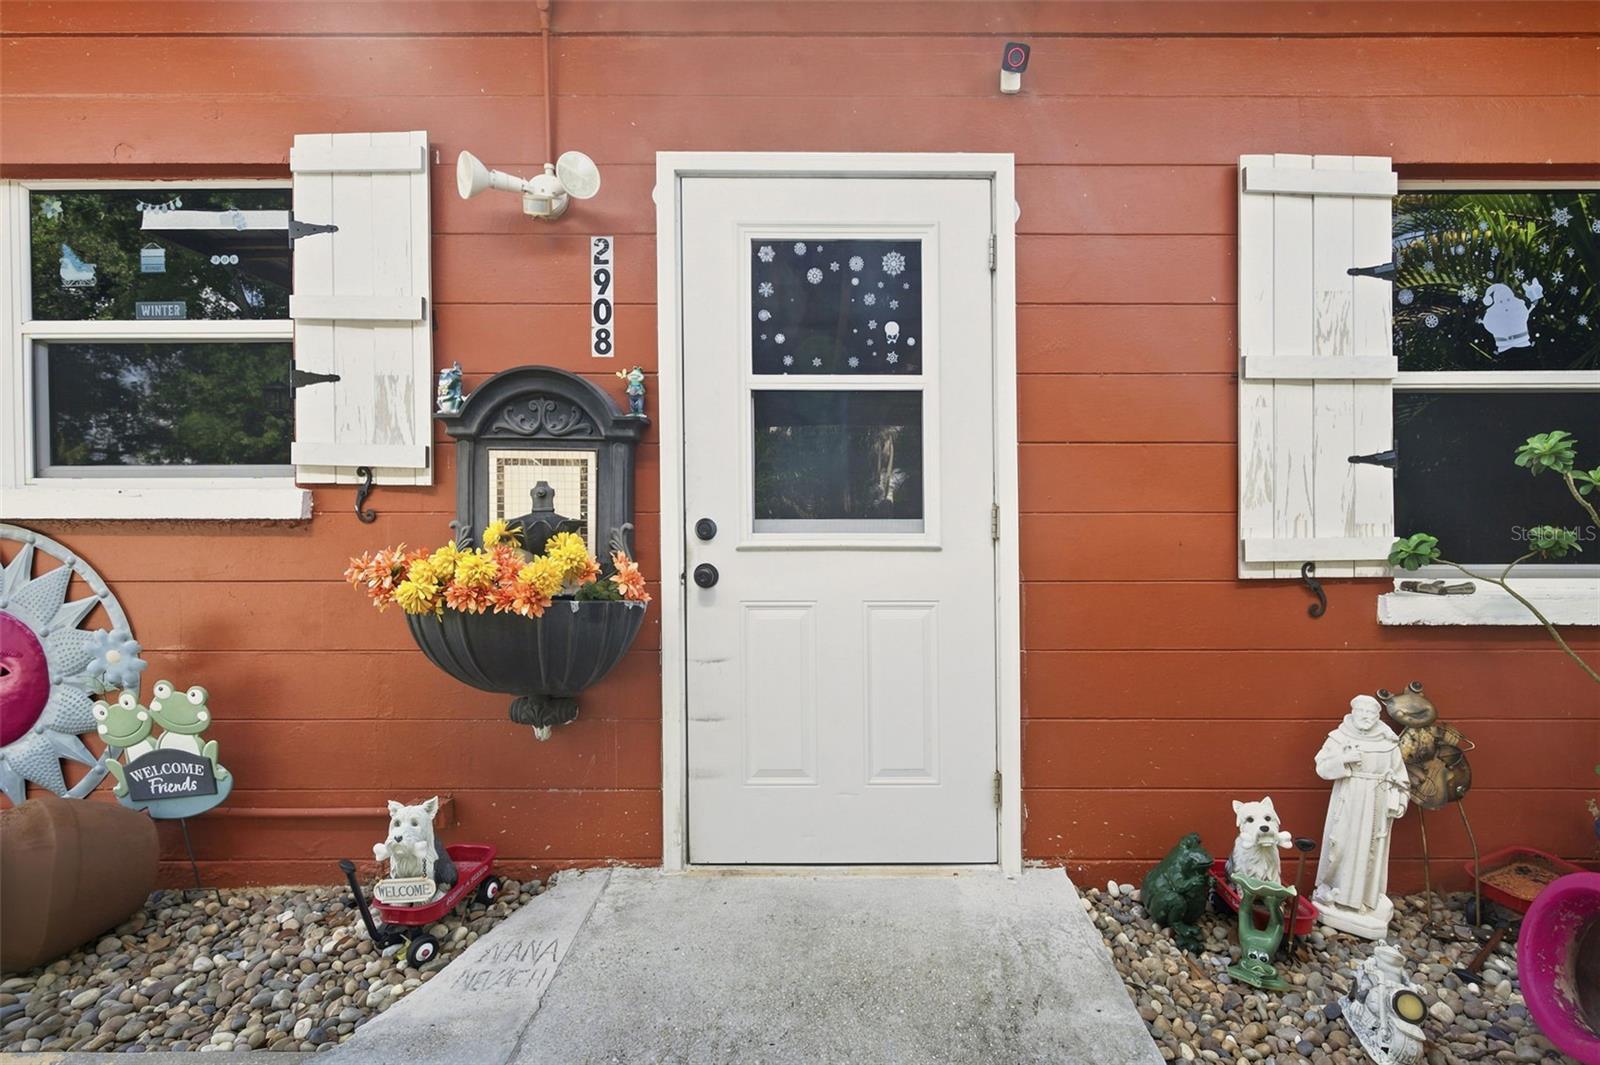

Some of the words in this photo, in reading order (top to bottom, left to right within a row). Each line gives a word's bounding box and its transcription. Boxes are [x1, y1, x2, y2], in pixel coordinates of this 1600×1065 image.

[593, 238, 612, 355] 2908
[141, 304, 181, 317] WINTER
[129, 762, 205, 783] WELCOME
[148, 776, 198, 795] Friends
[376, 883, 432, 899] WELCOME
[475, 937, 559, 967] NANA
